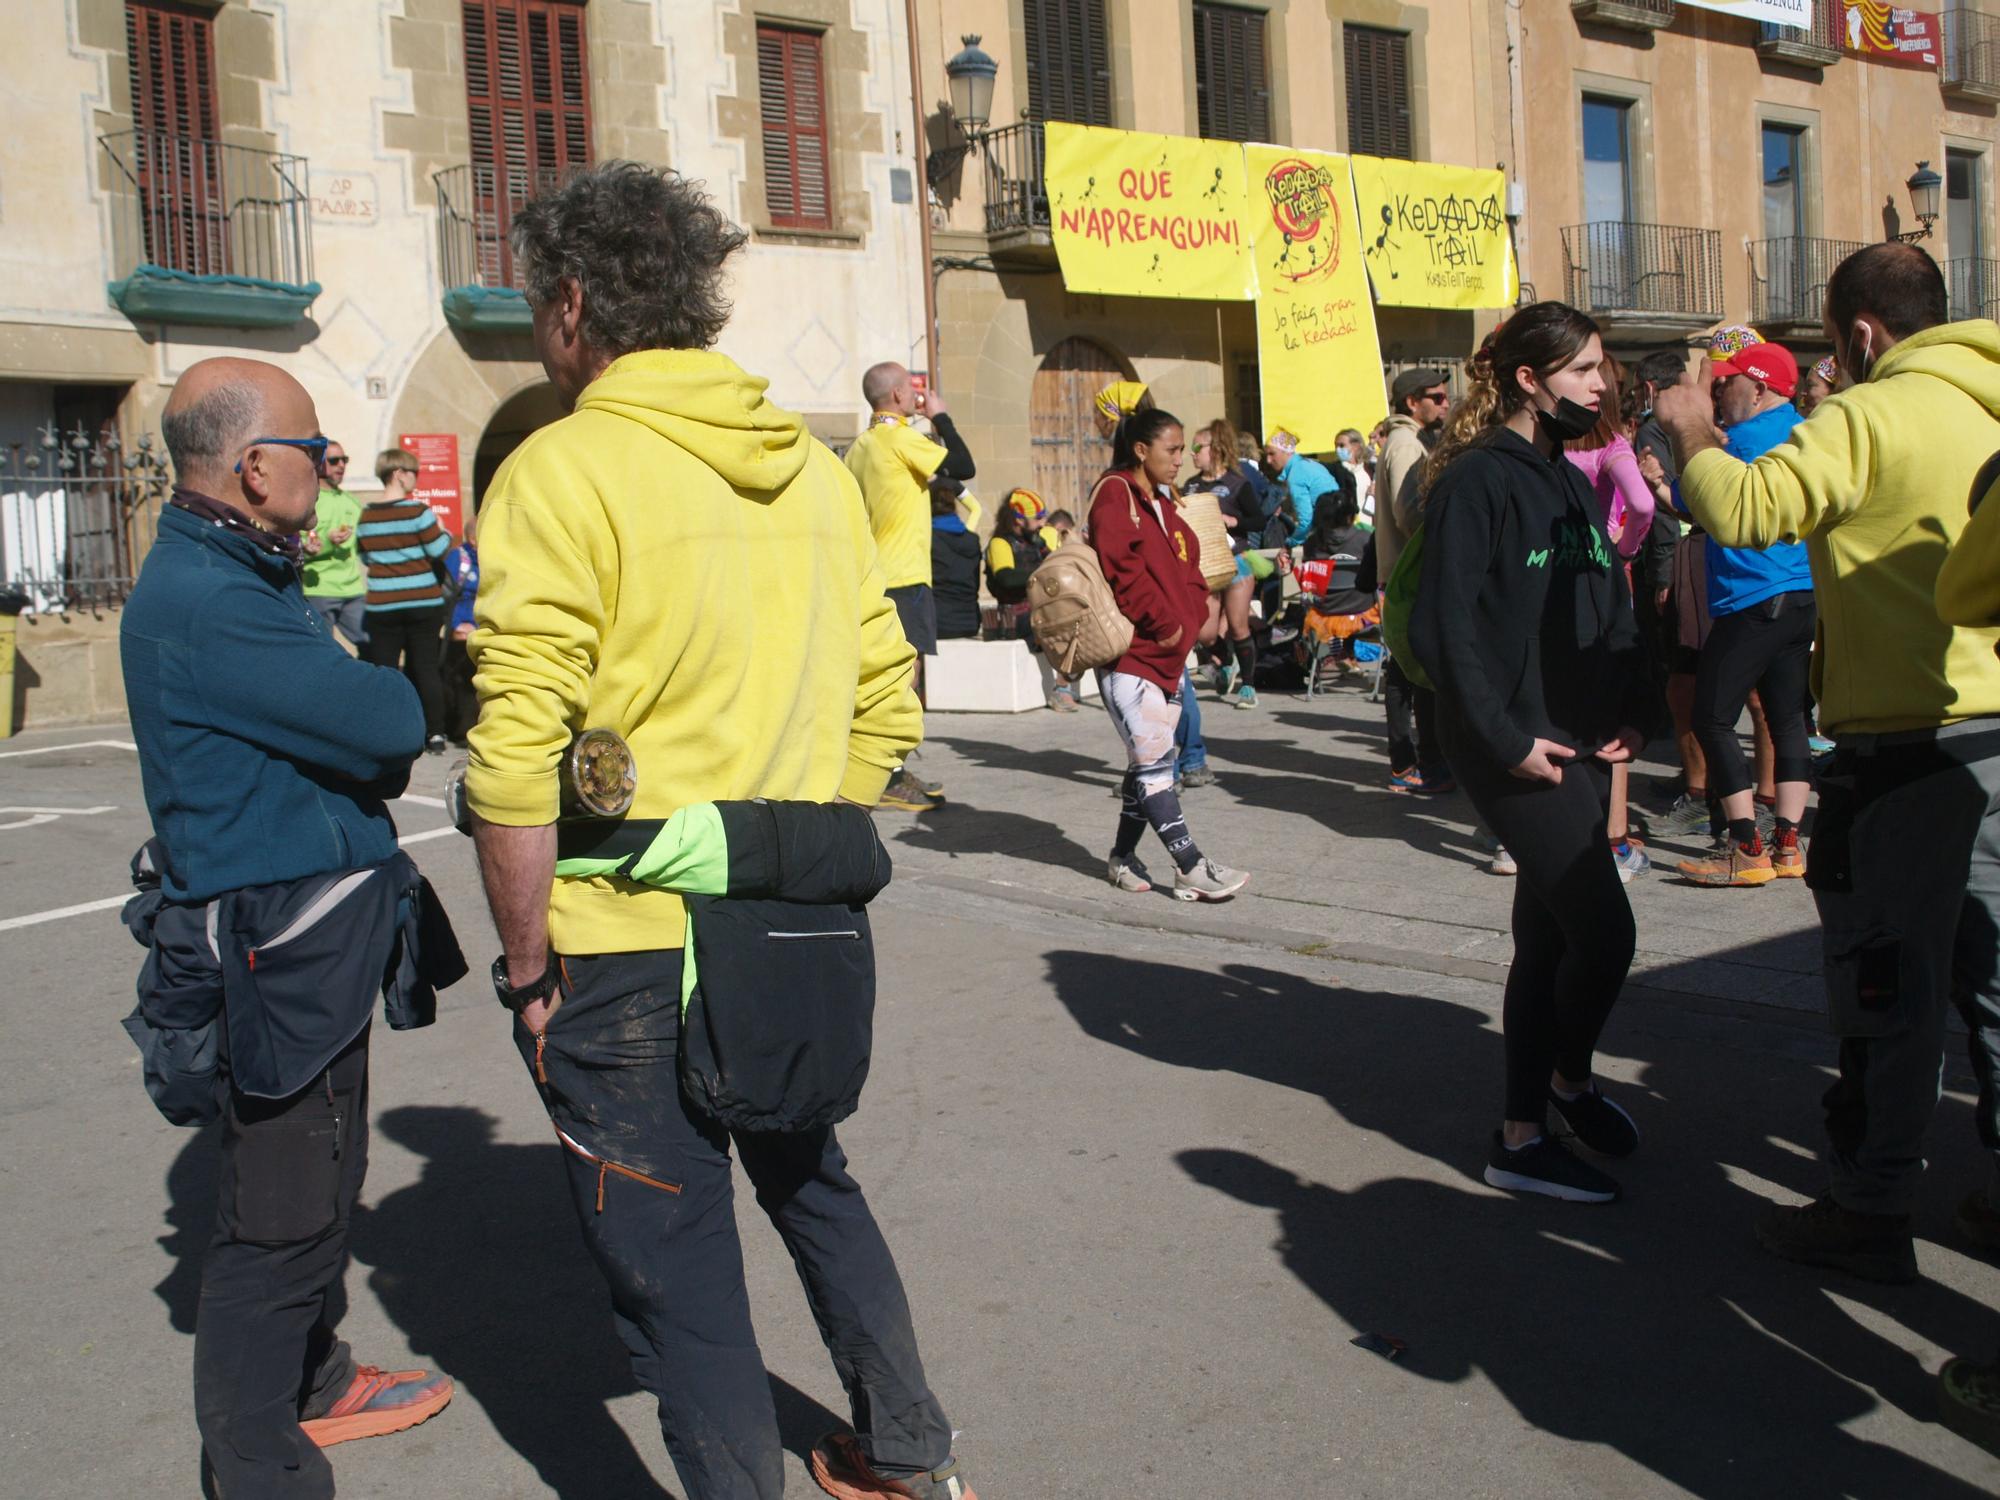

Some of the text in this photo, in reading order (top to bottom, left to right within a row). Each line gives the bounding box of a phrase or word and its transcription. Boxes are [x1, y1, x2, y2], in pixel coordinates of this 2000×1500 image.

[1119, 168, 1172, 201] QUE
[1061, 206, 1240, 255] N'APRENGUIN!
[1291, 302, 1318, 327] faig
[1324, 299, 1356, 321] gran
[1284, 333, 1300, 350] la
[431, 488, 457, 497] Museu
